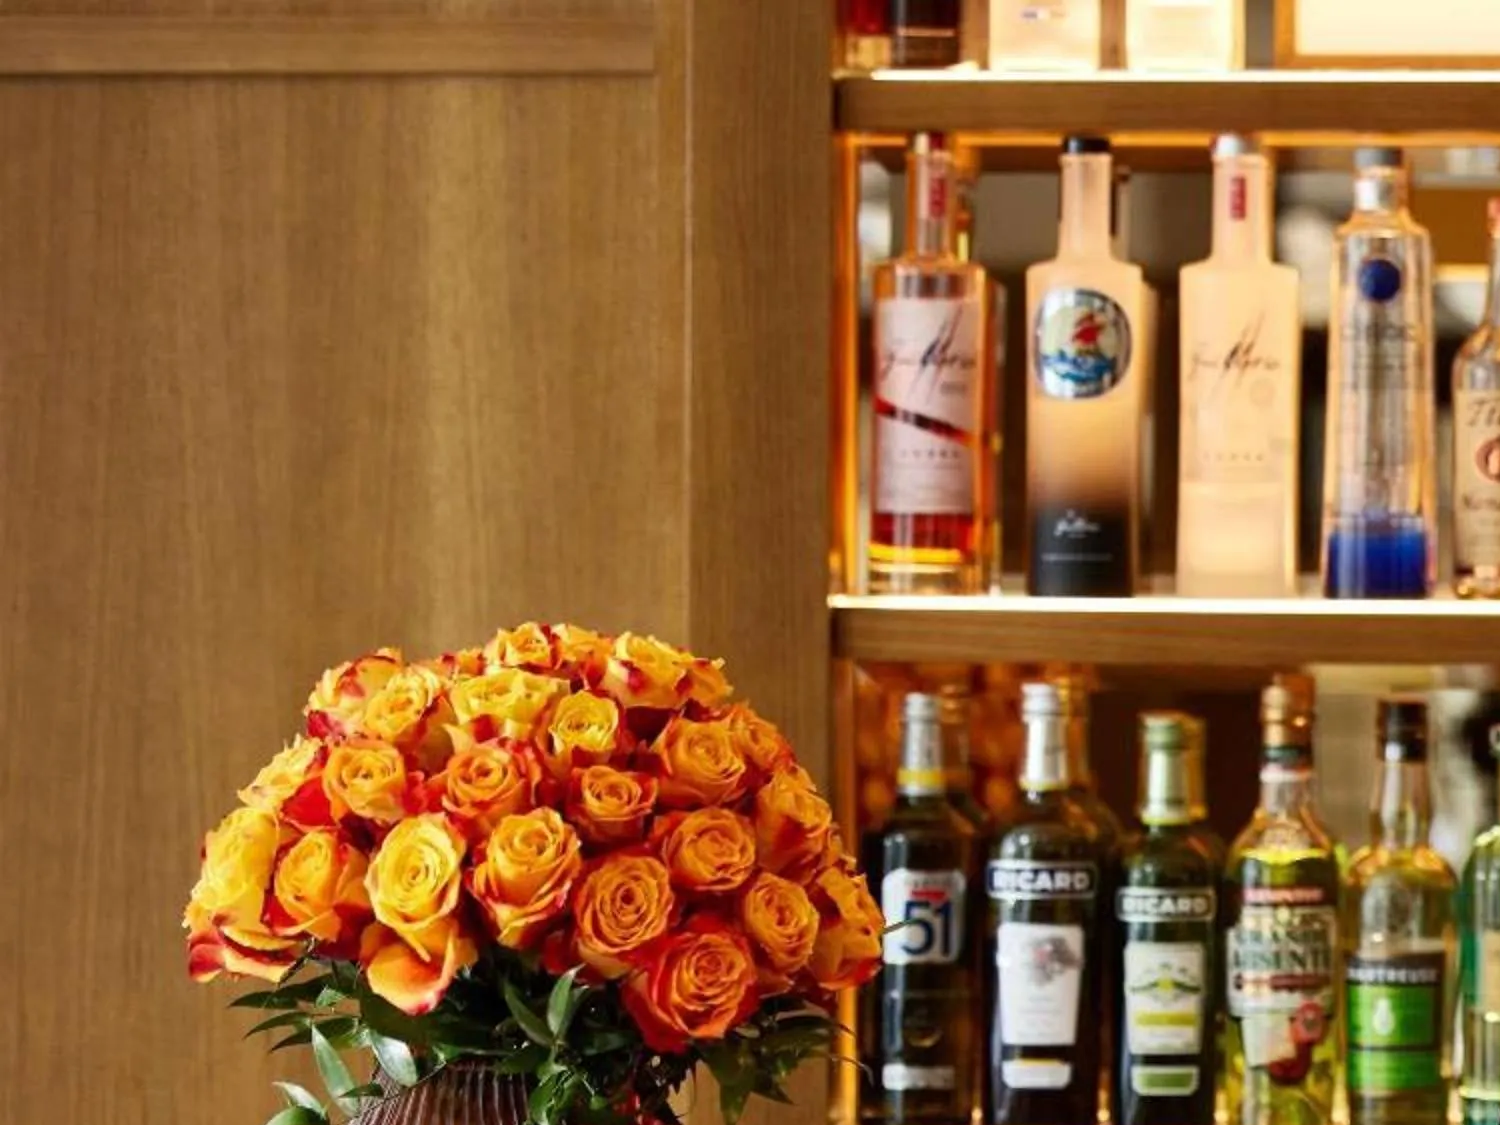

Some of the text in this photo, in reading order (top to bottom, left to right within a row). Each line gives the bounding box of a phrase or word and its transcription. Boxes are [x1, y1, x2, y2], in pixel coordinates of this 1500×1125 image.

[993, 869, 1090, 891] RICARD
[1122, 896, 1207, 914] RICARD
[901, 899, 953, 958] 51
